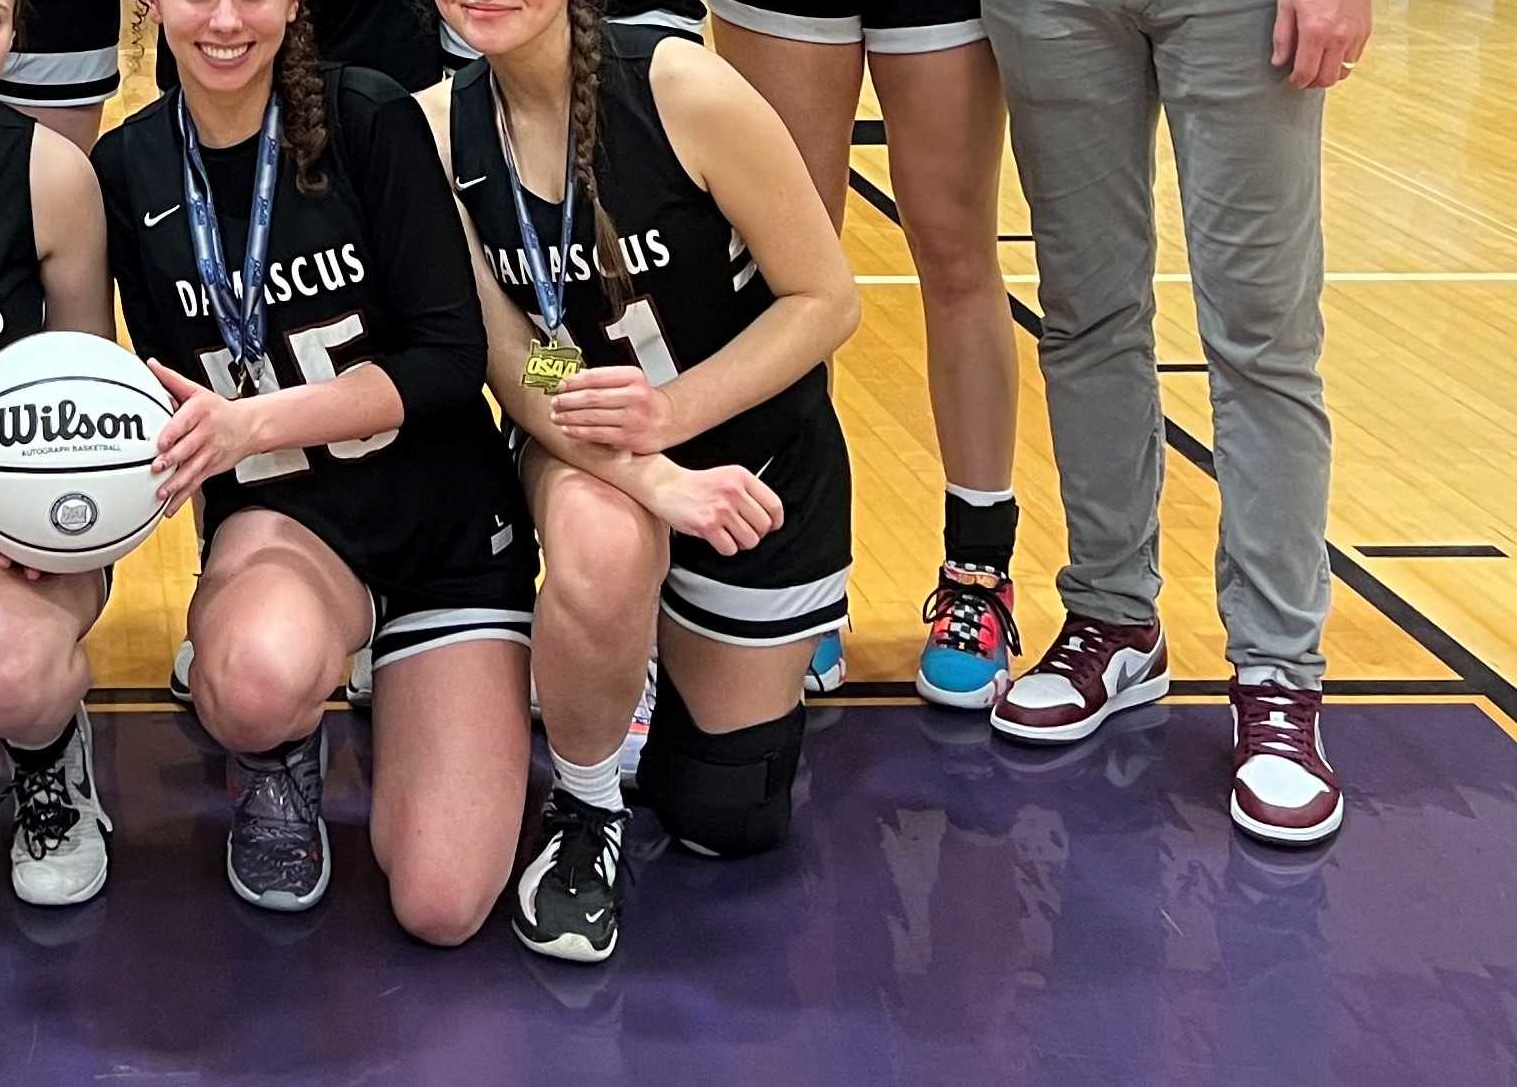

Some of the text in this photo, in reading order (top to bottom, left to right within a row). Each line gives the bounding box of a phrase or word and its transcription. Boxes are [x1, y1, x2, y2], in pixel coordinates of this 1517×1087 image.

[175, 242, 365, 318] DSCUS
[527, 357, 578, 379] OSAA
[21, 444, 121, 457] AUTOGRAPH BASKETBALL
